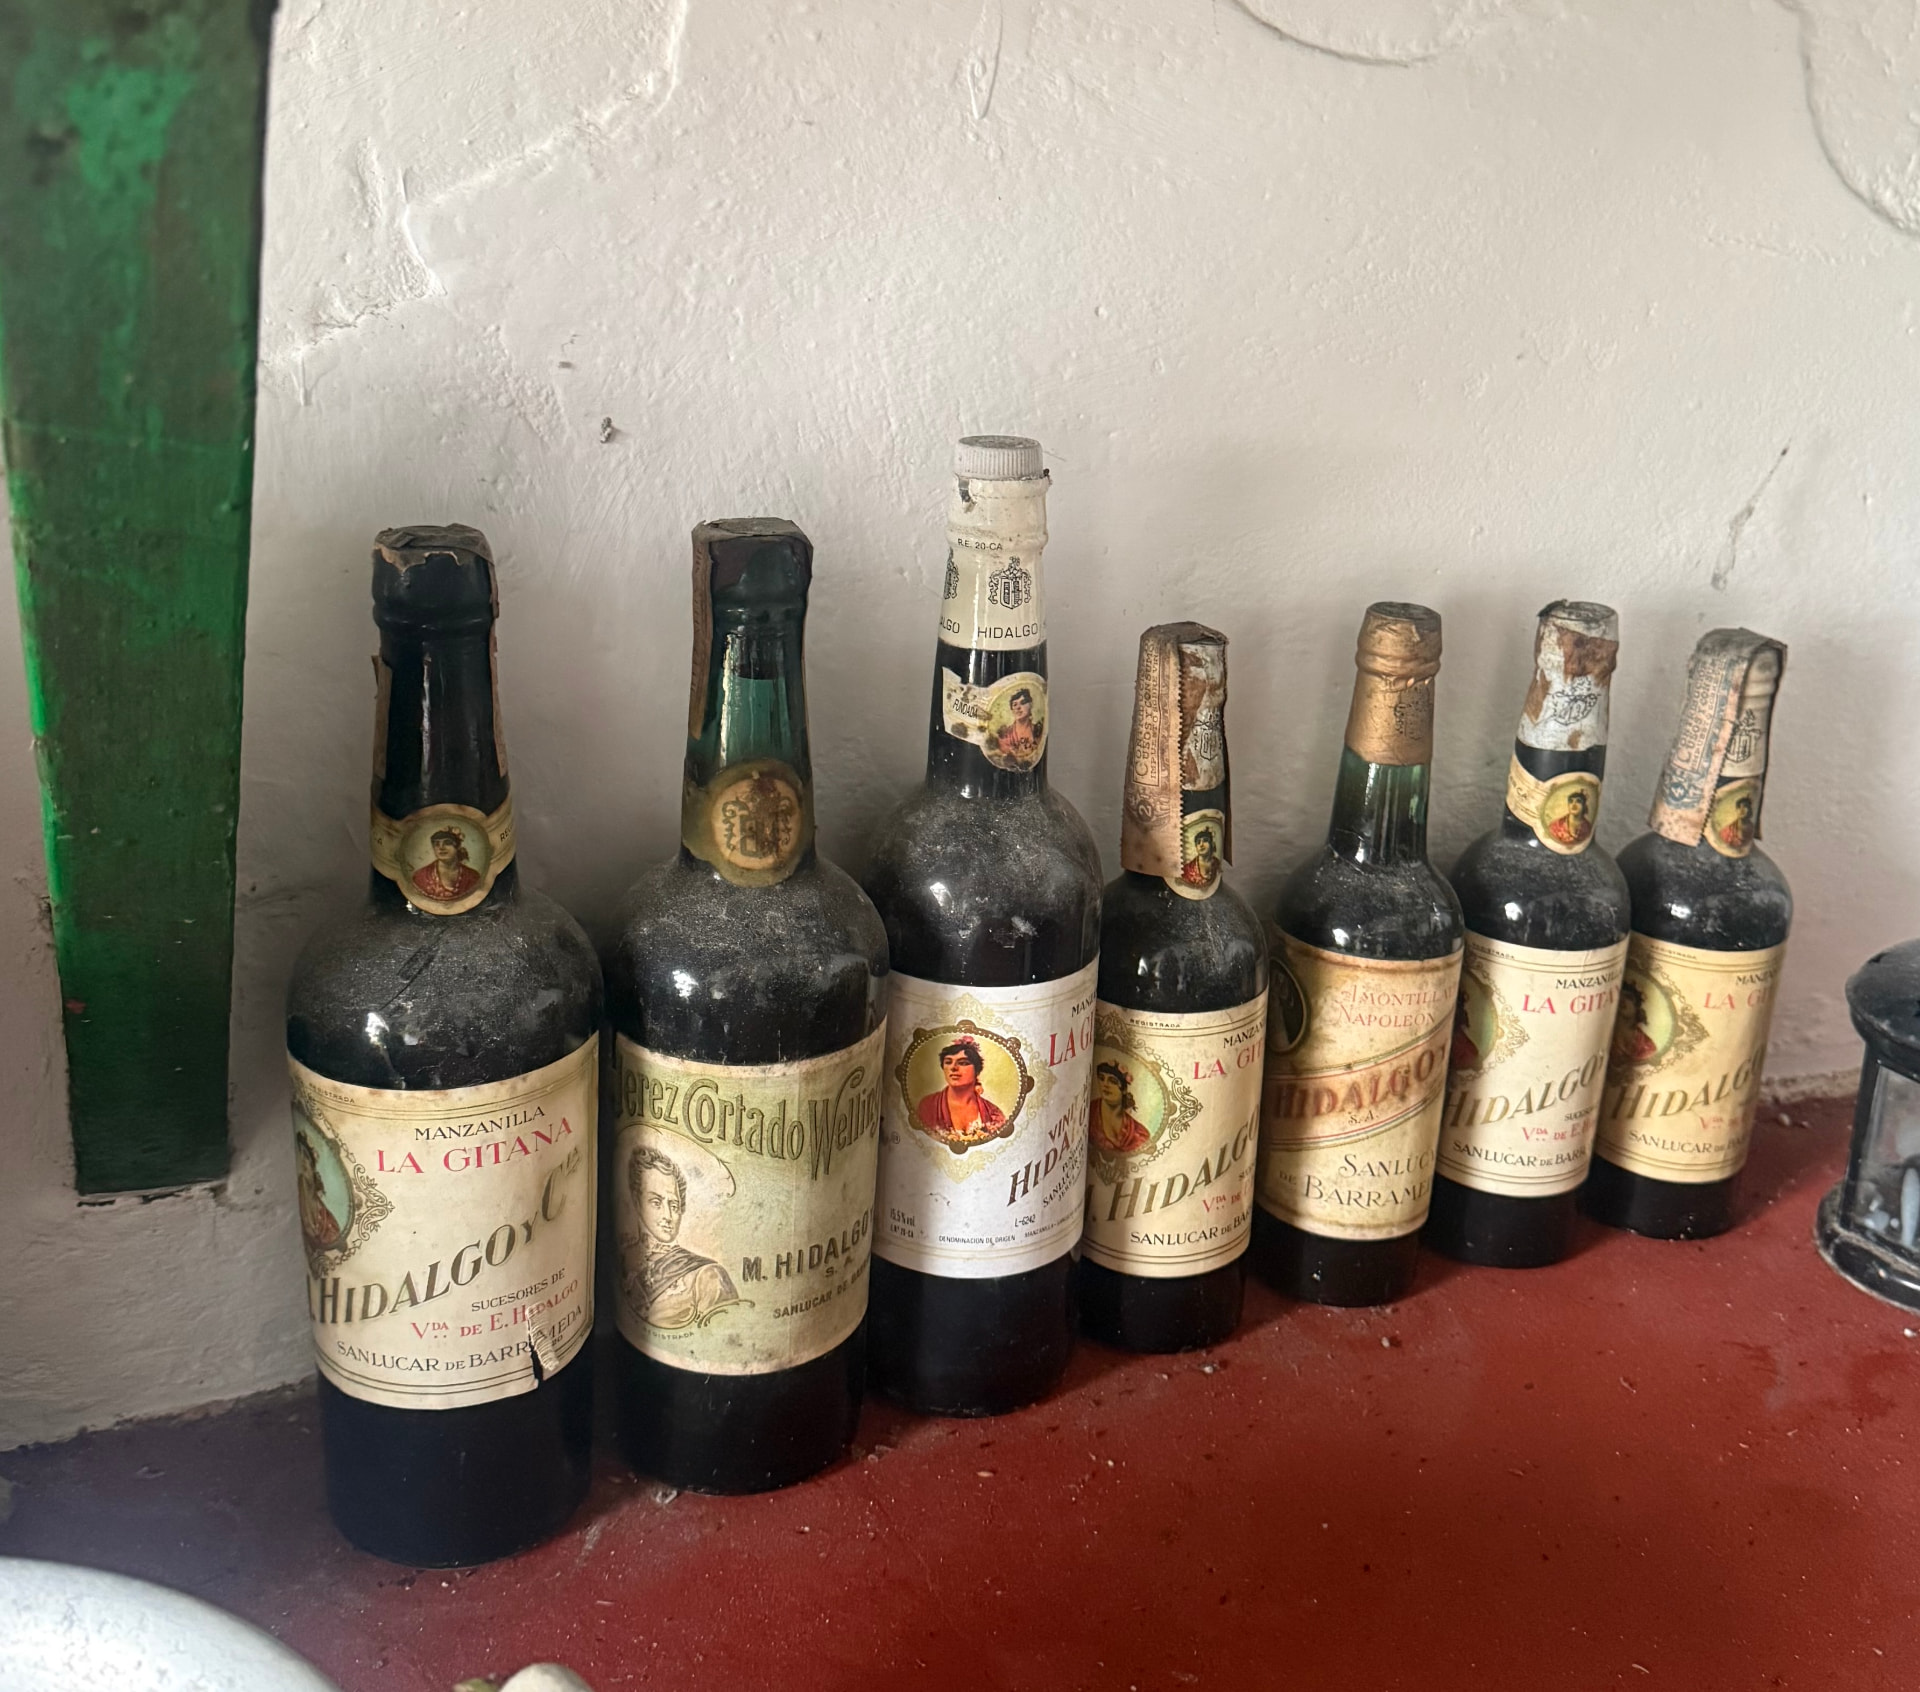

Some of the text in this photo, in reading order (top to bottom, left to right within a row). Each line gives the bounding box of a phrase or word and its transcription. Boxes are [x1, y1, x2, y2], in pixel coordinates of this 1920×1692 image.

[975, 541, 1003, 551] 20-CA
[977, 622, 1038, 639] HIDALGO
[1335, 1000, 1435, 1028] NAPOLEON
[1523, 994, 1556, 1014] LA
[1704, 992, 1735, 1010] LA
[1130, 1018, 1181, 1028] REGISTRADA
[1048, 1026, 1076, 1068] LA
[1193, 1058, 1227, 1080] LA
[414, 1106, 546, 1141] MANZANILLA
[682, 1078, 804, 1160] Cortado
[377, 1116, 573, 1174] LA GITANA
[1453, 1140, 1537, 1167] SANLUCAR
[1629, 1129, 1713, 1153] SANLUCAR
[1107, 1104, 1259, 1221] HIDALGO
[742, 1209, 869, 1282] M. HIDALGO
[939, 1235, 984, 1244] DENOMINACION
[995, 1235, 1016, 1243] ORIGEN
[1130, 1226, 1219, 1246] SANLUCAR
[1221, 1223, 1233, 1235] DE
[319, 1223, 516, 1324] HIDALGO
[825, 1266, 838, 1278] S.
[471, 1267, 566, 1312] SUCESORES DE
[773, 1290, 833, 1319] SANLUCAR
[460, 1324, 483, 1337] DE
[490, 1312, 509, 1332] E.
[337, 1340, 440, 1372] SANLUCAR
[446, 1360, 466, 1371] DE
